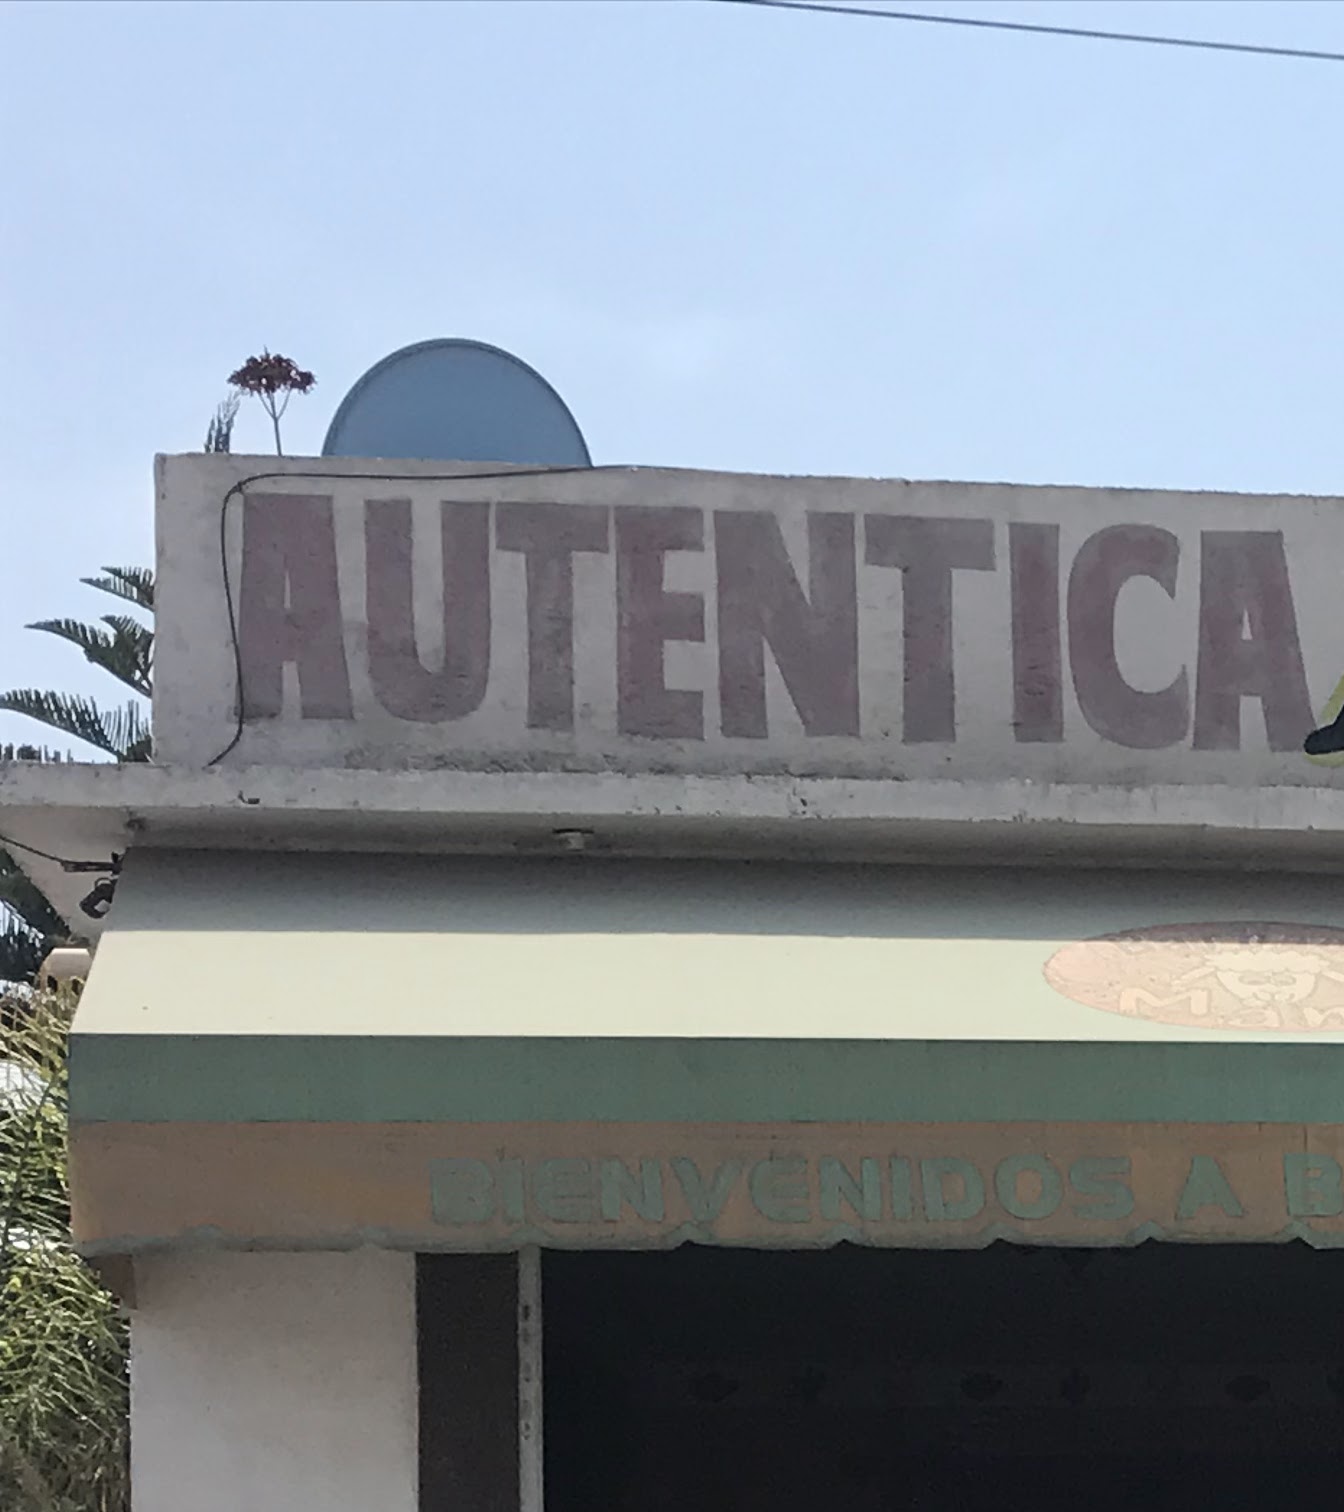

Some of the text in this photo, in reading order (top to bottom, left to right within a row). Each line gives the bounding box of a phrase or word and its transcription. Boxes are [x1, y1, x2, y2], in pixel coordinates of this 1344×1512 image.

[237, 491, 1317, 754] AUTENTICA
[428, 1152, 1136, 1224] BIENVENIDOS
[1175, 1155, 1247, 1220] A
